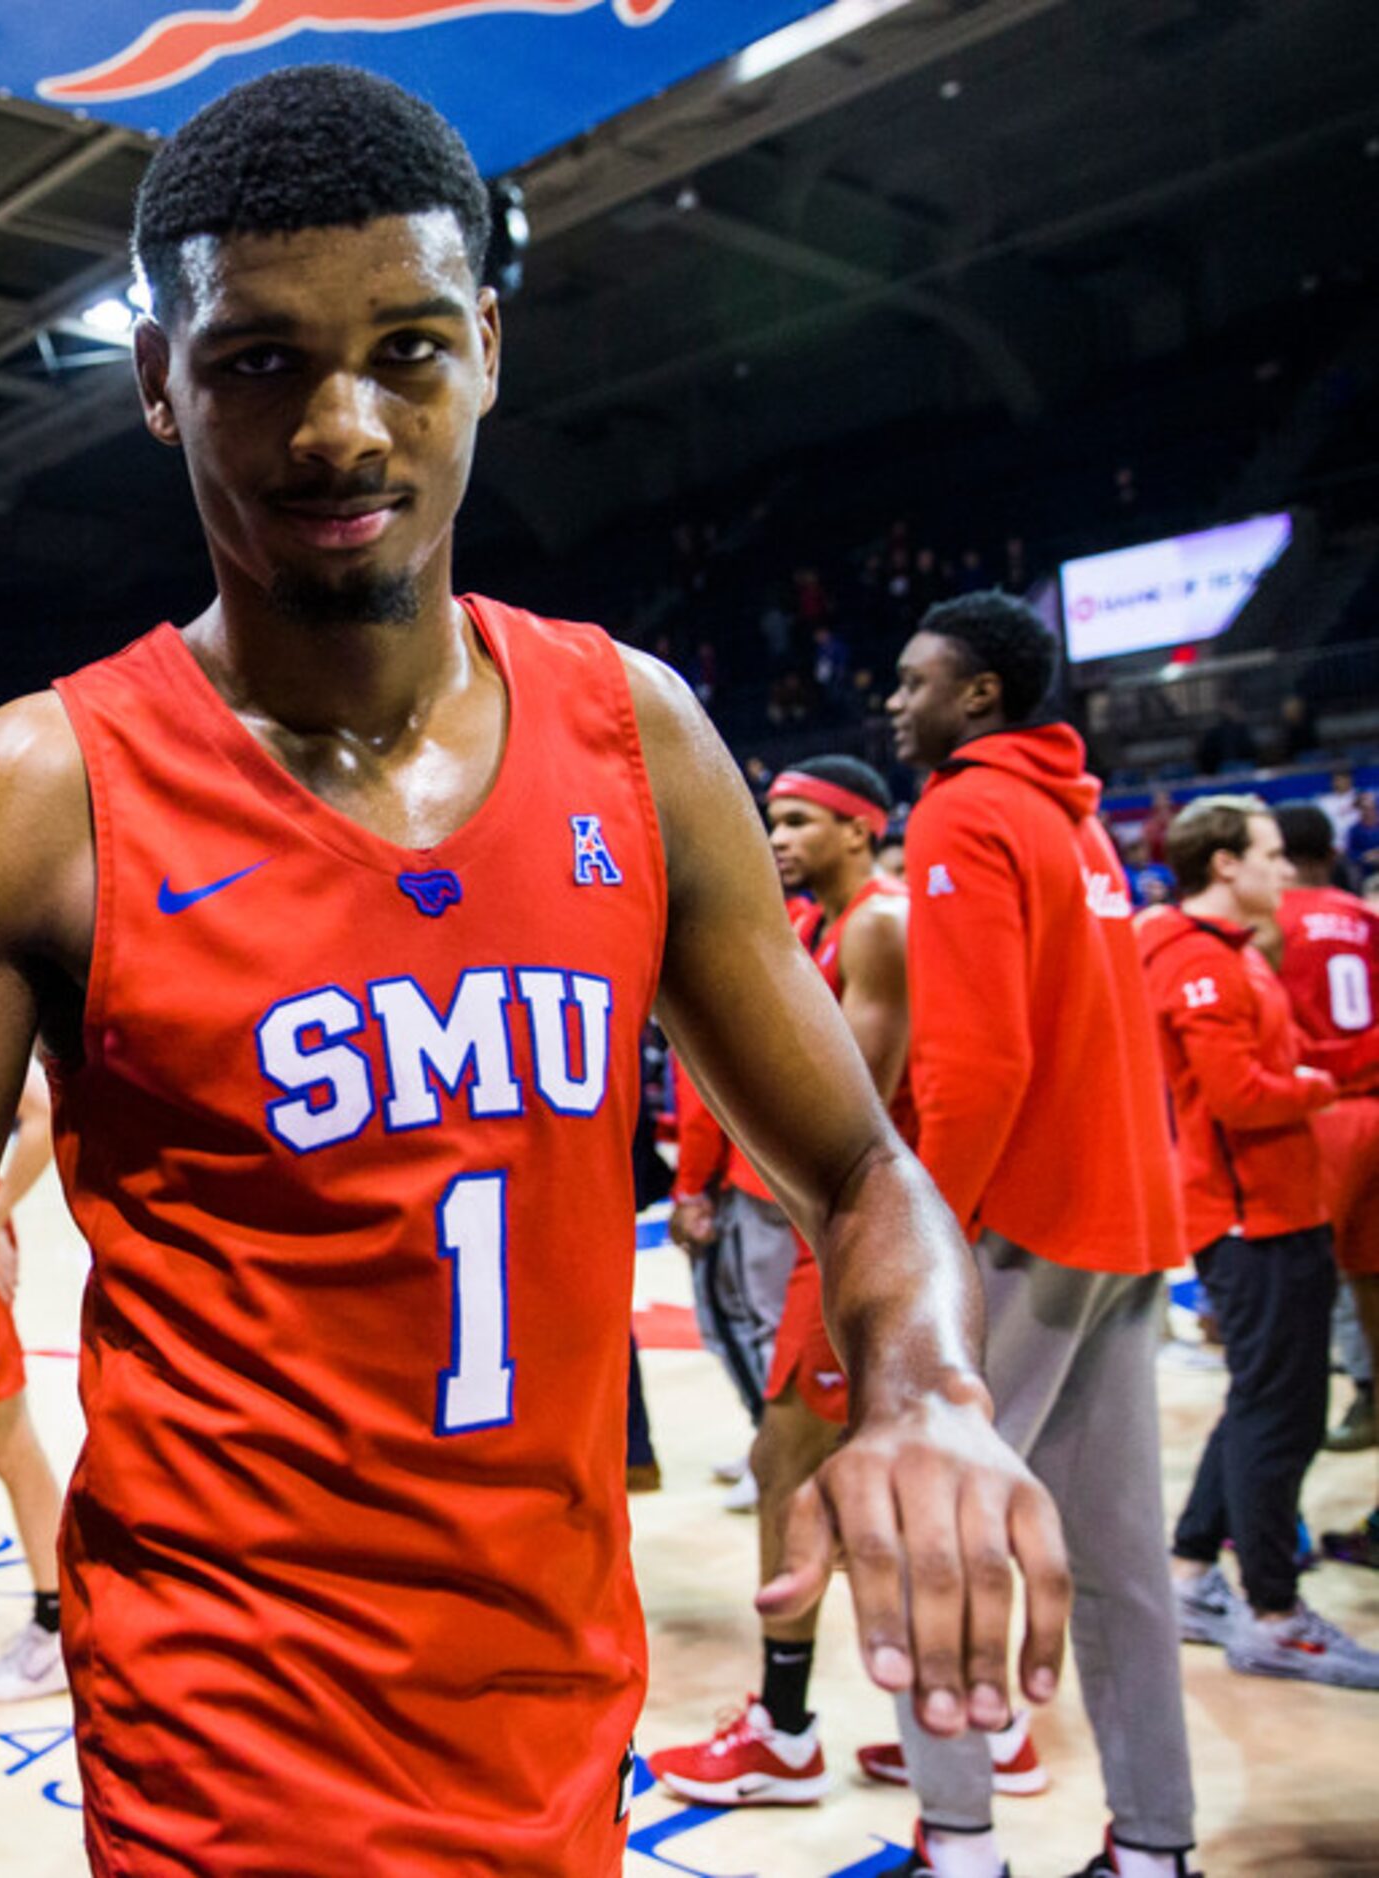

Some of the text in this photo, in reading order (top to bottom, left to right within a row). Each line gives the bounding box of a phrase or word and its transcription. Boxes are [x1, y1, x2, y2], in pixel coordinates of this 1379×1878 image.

[255, 965, 612, 1155] SMU
[1326, 952, 1372, 1030] 0
[433, 1168, 516, 1437] 1
